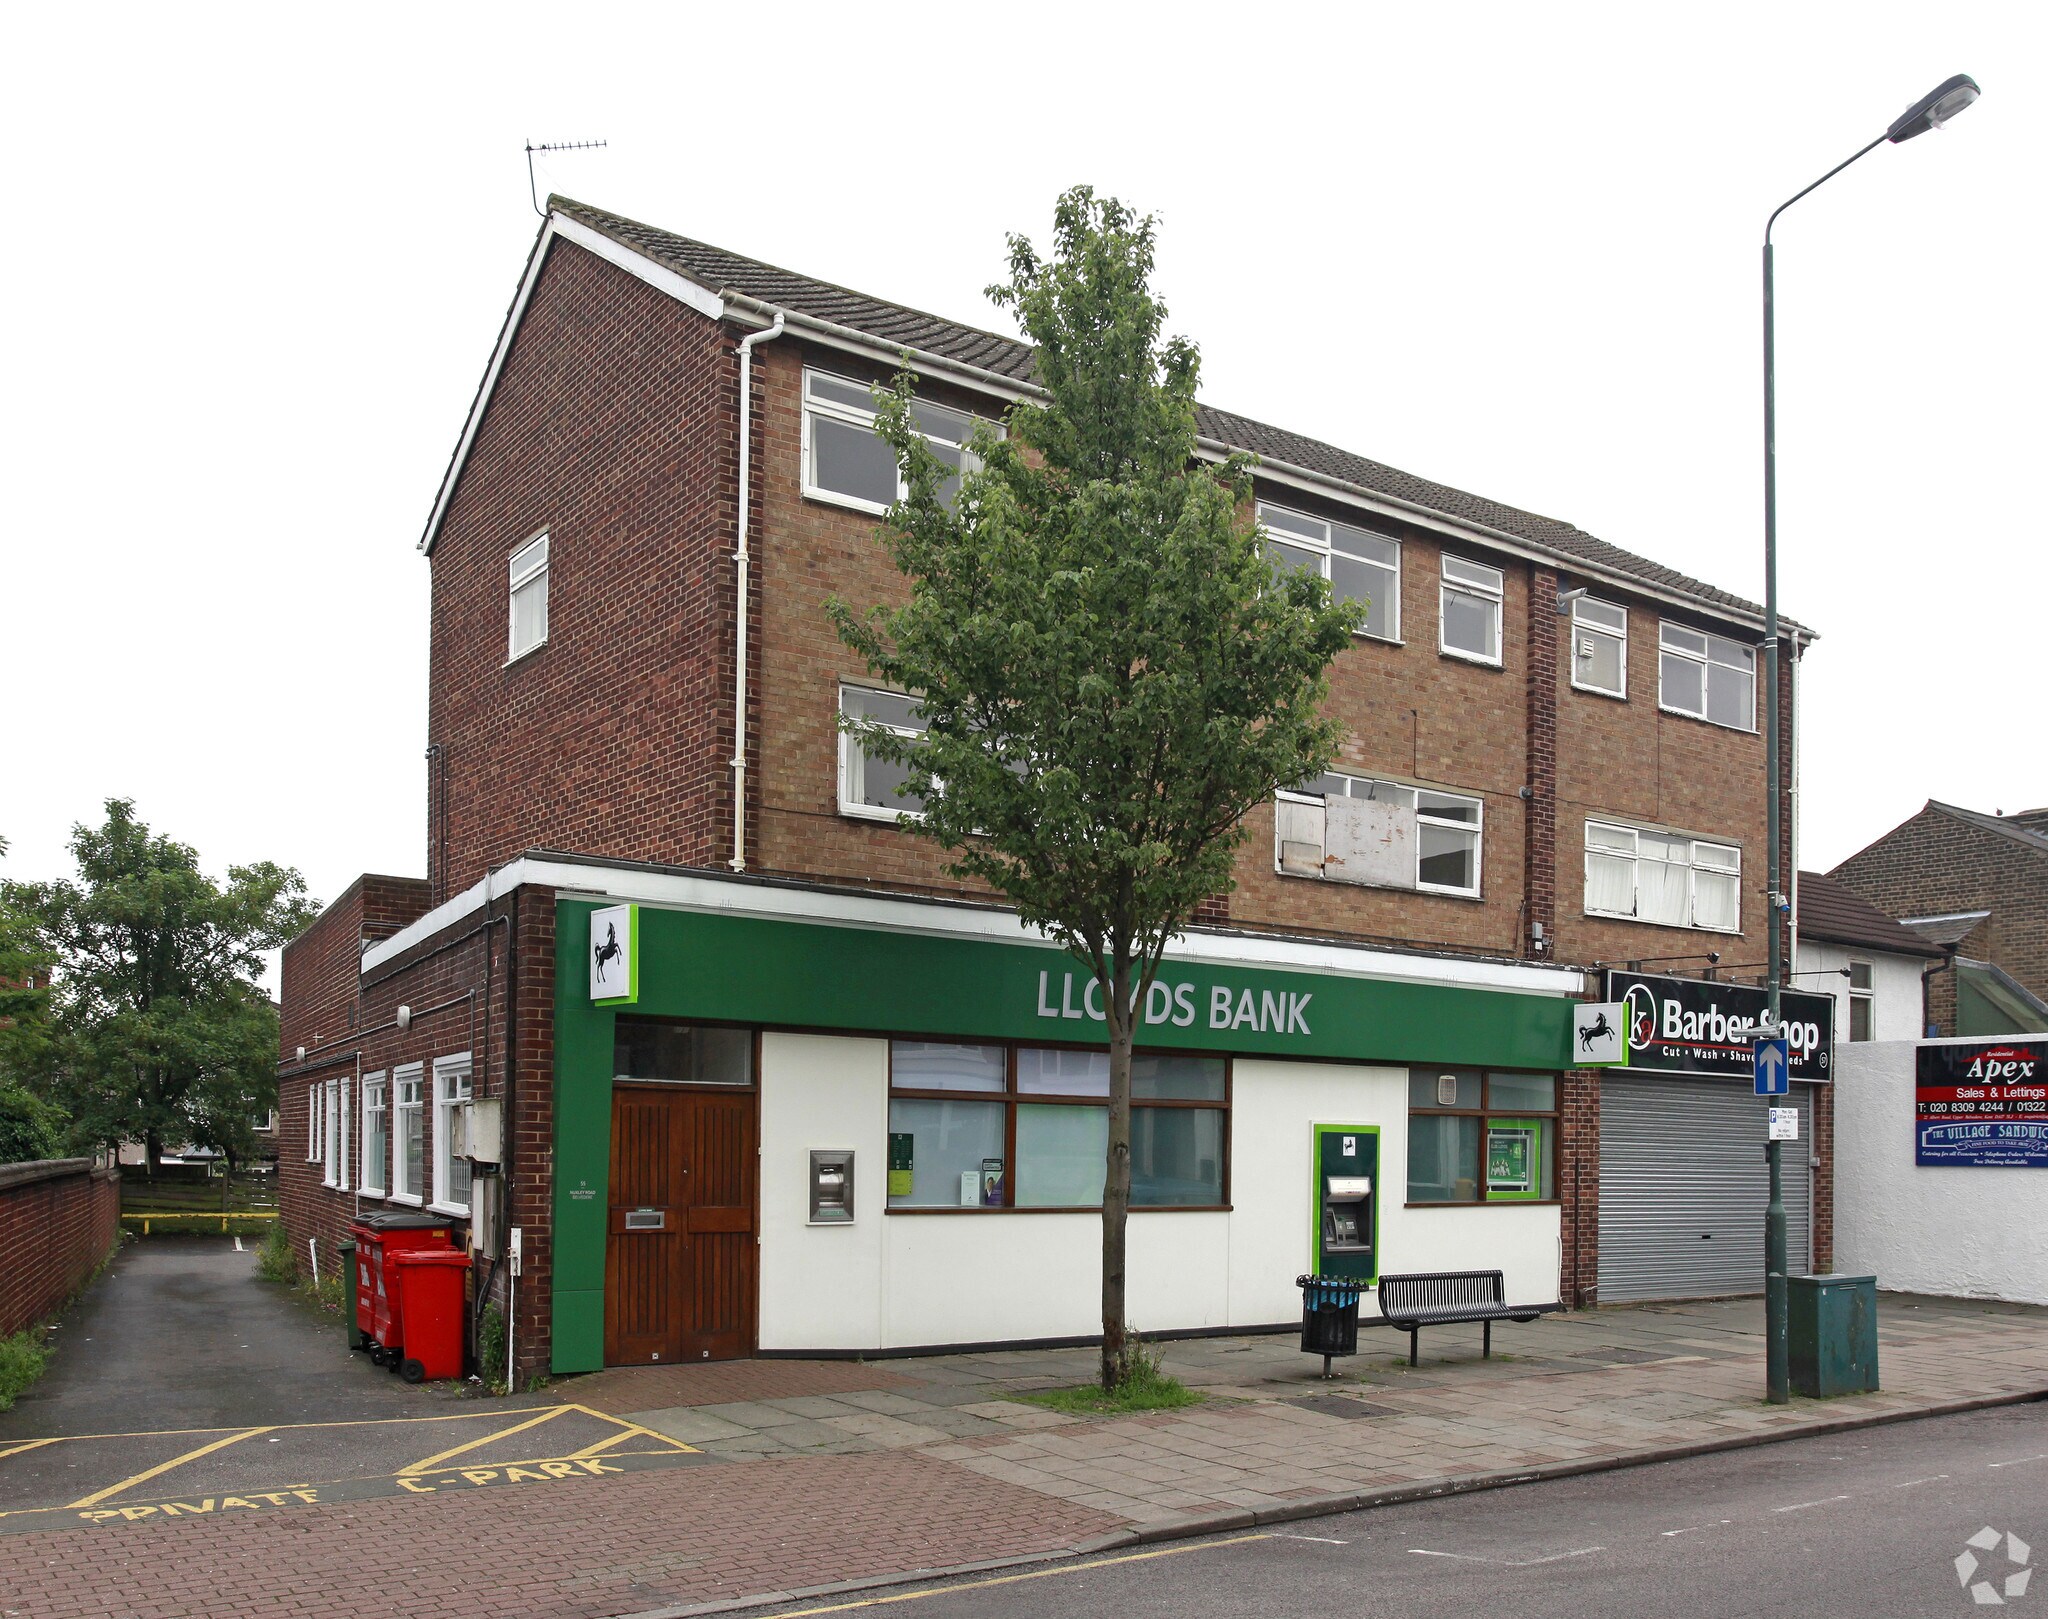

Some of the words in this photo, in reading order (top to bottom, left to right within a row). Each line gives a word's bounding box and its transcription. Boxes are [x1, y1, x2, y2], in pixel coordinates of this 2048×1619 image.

[1037, 970, 1196, 1028] LLODS
[1209, 985, 1313, 1036] BANK
[1662, 999, 1755, 1044] Barber
[1662, 1046, 1680, 1057] Cut
[1693, 1047, 1718, 1060] Wash
[1966, 1057, 2035, 1085] Apex
[1956, 1088, 1985, 1099] Sales
[1990, 1087, 1999, 1098] &
[2004, 1087, 2046, 1100] Lettings
[1918, 1103, 1926, 1113] T:
[1930, 1103, 1947, 1113] 020
[1951, 1102, 1975, 1112] 8309
[1979, 1102, 2004, 1112] 4244
[2017, 1101, 2046, 1112] 01322
[1771, 1111, 1776, 1123] P
[1932, 1130, 1944, 1139] THE
[1947, 1125, 1991, 1140] VILLAGE
[395, 1458, 624, 1493] C-PARK
